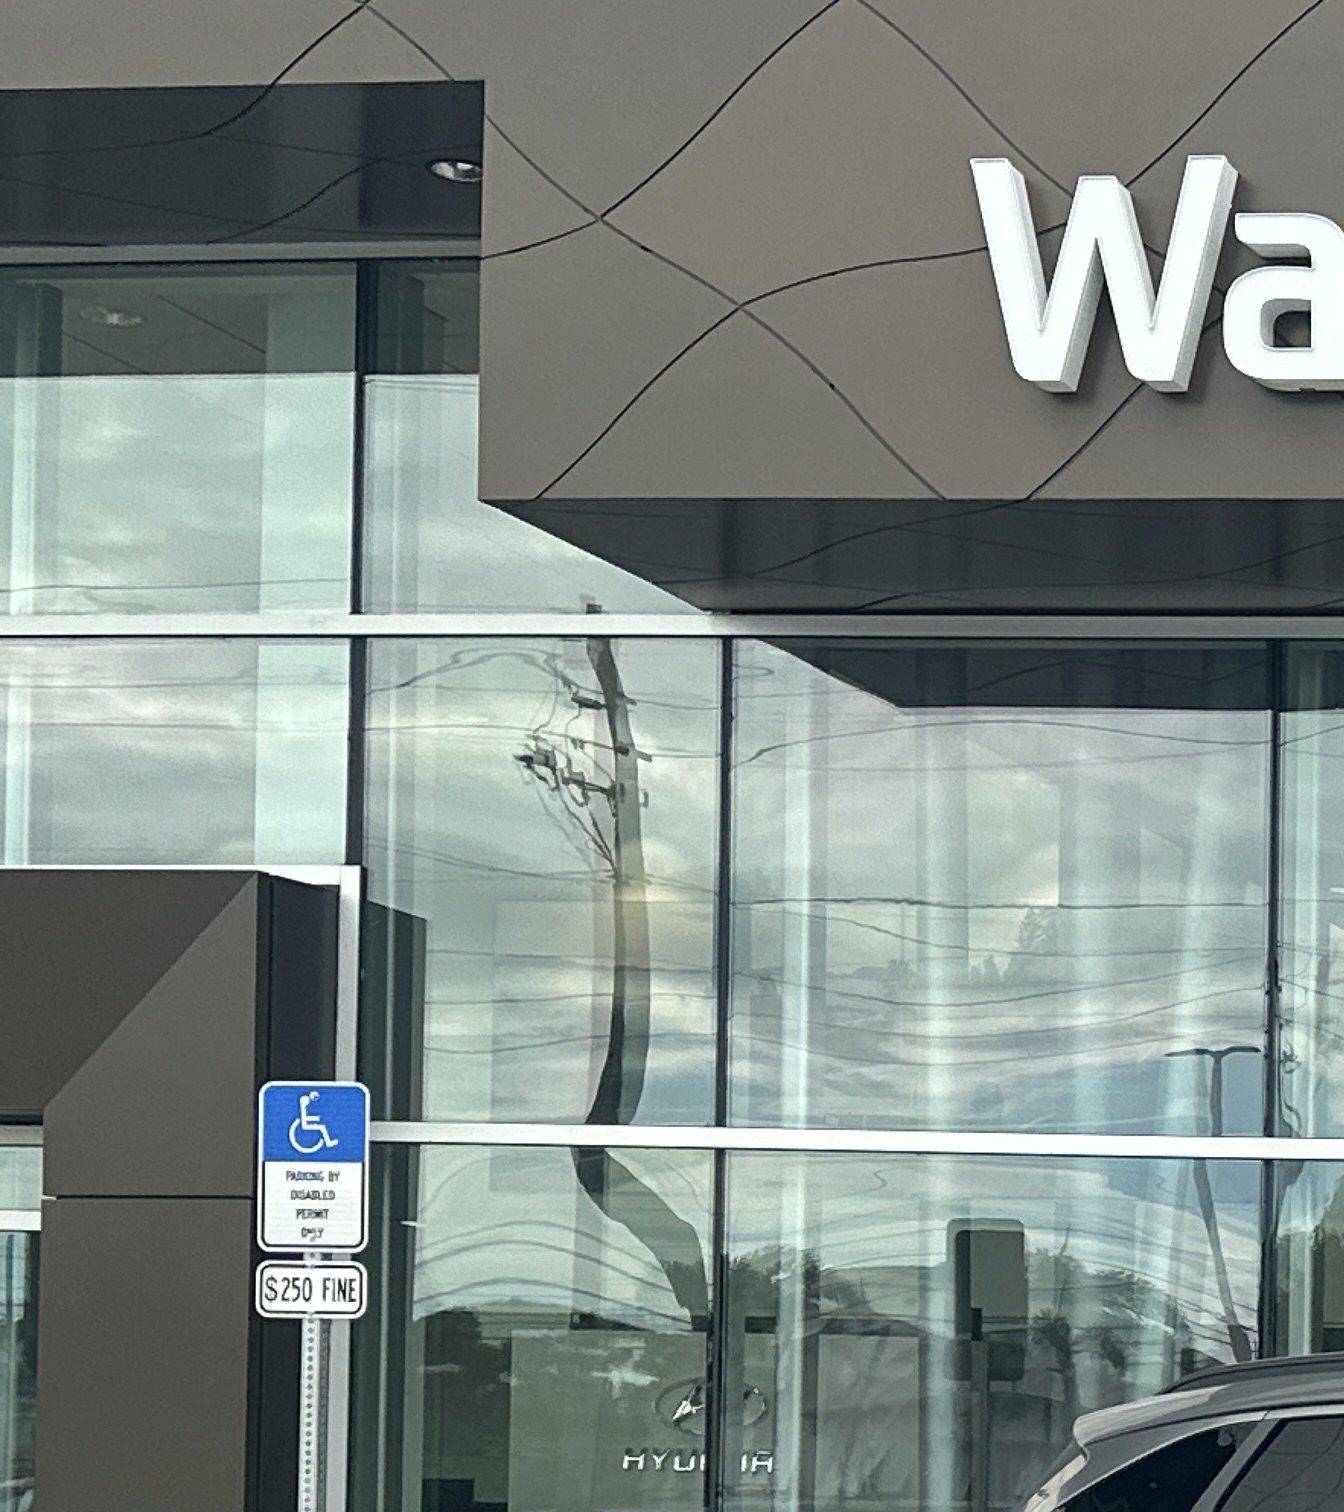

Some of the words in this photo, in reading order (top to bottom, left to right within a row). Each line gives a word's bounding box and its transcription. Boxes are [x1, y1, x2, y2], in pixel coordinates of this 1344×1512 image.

[328, 1170, 340, 1182] BY
[290, 1189, 336, 1200] DISABLED
[295, 1208, 330, 1219] PERMIT
[264, 1276, 313, 1303] $250
[322, 1277, 358, 1303] FINE
